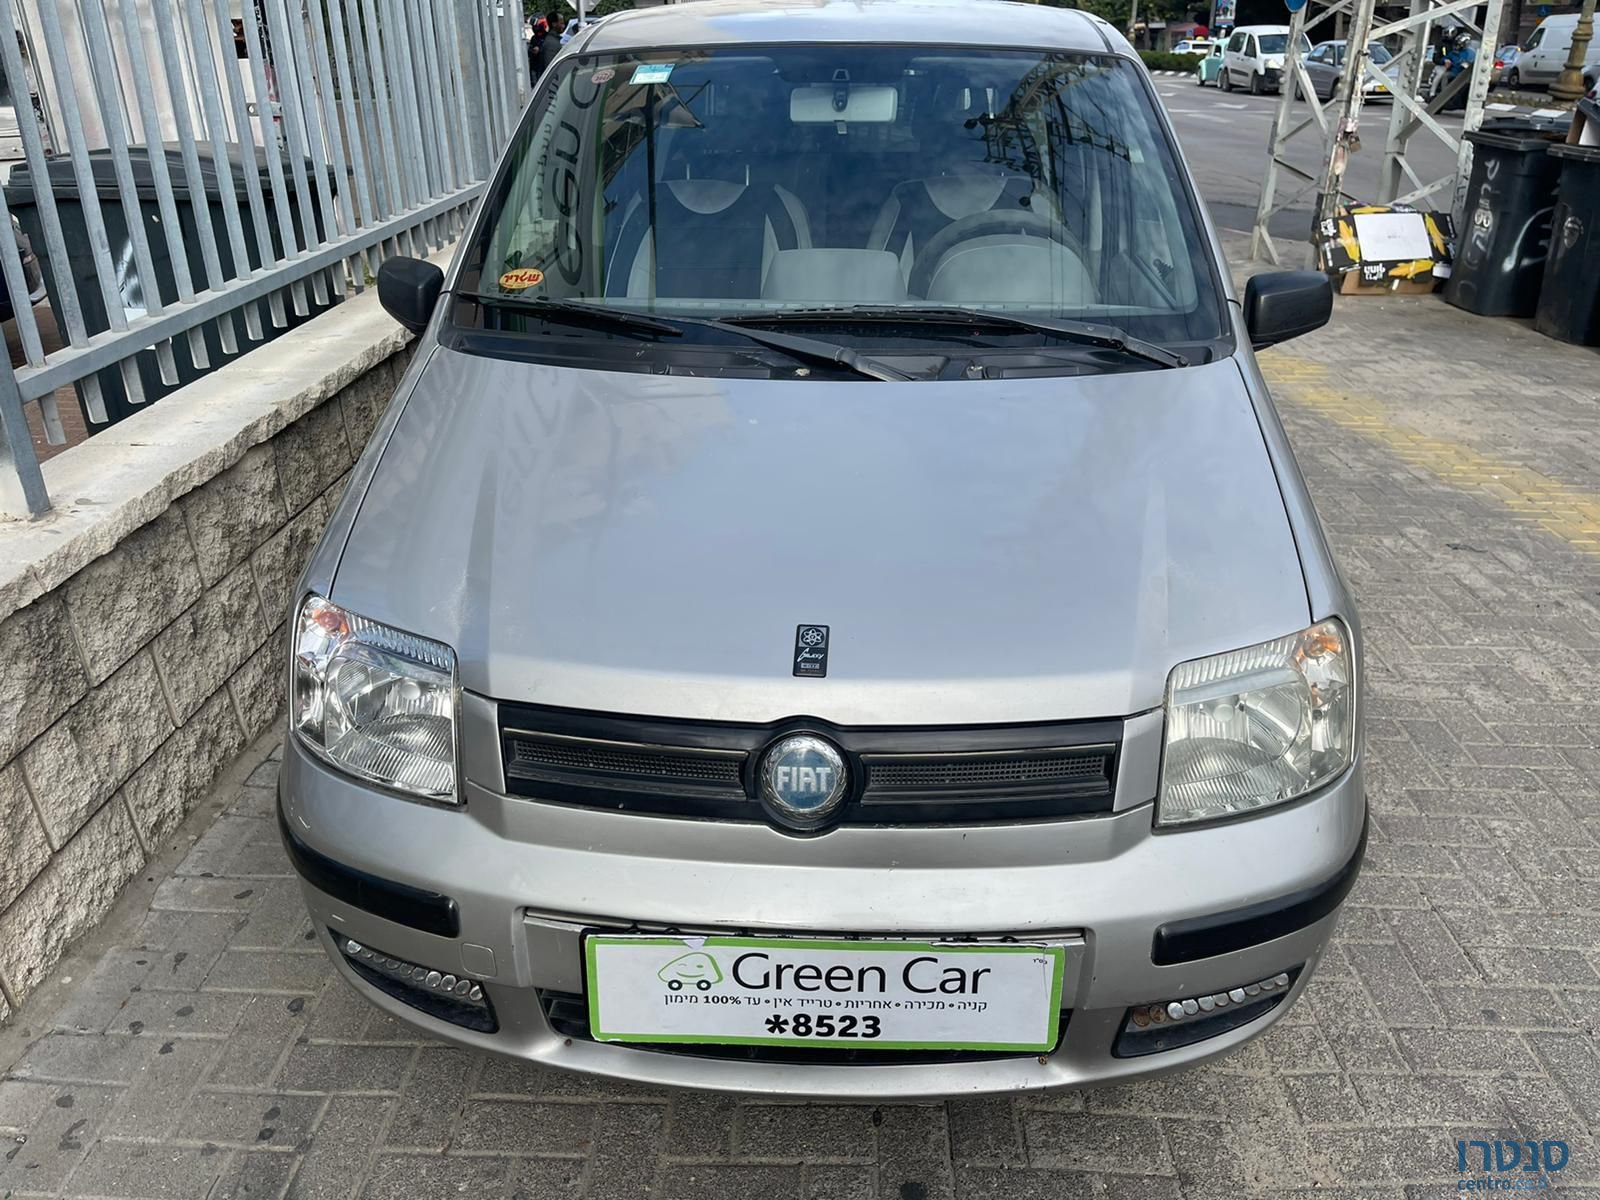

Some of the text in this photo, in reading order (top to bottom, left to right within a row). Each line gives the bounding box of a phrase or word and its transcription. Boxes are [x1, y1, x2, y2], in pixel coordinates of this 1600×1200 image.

[777, 765, 831, 792] FIAT
[732, 952, 991, 995] Green Car
[664, 994, 988, 1013] קניה מכירה אחריות טרייד אין עד 100% מימון
